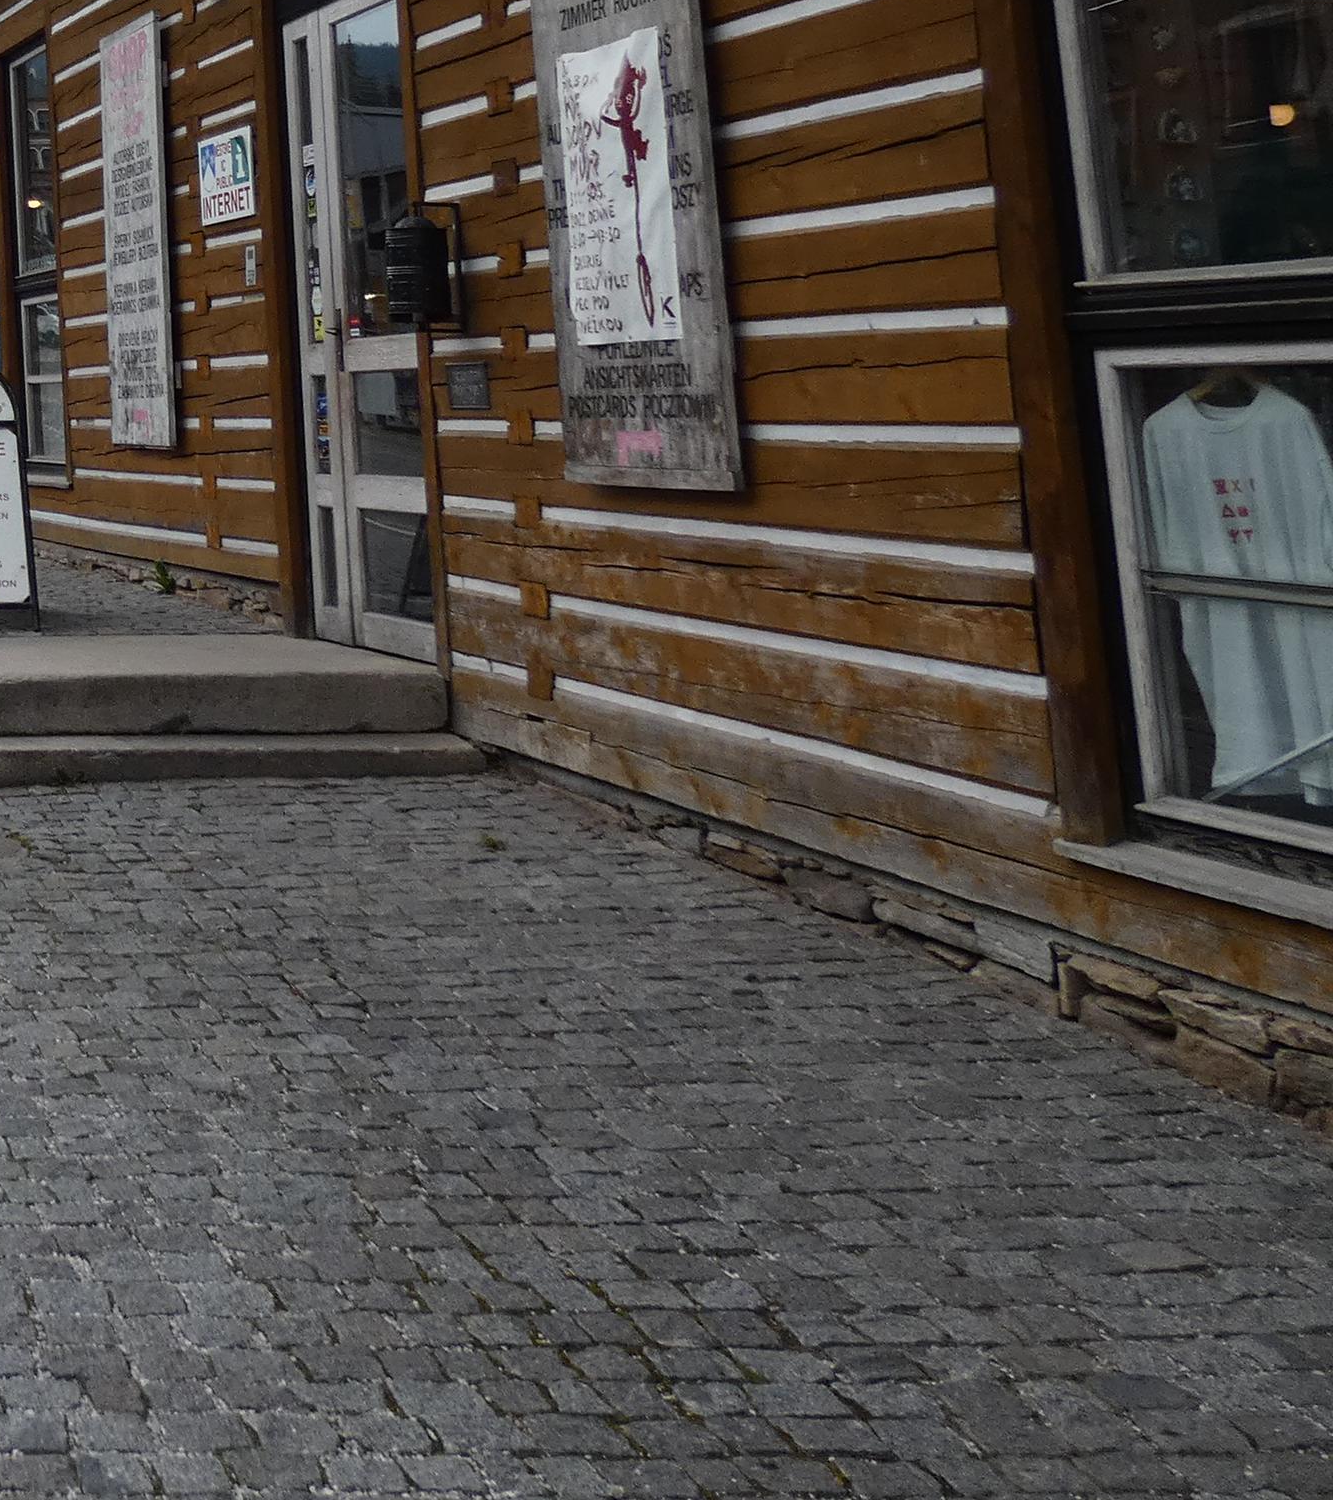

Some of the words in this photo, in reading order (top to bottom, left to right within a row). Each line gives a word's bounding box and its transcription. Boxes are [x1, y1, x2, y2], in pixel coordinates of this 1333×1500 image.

[203, 186, 251, 220] INTERNET
[585, 363, 691, 389] ANSICHTSKARTEN
[569, 394, 636, 418] POSTCARDS
